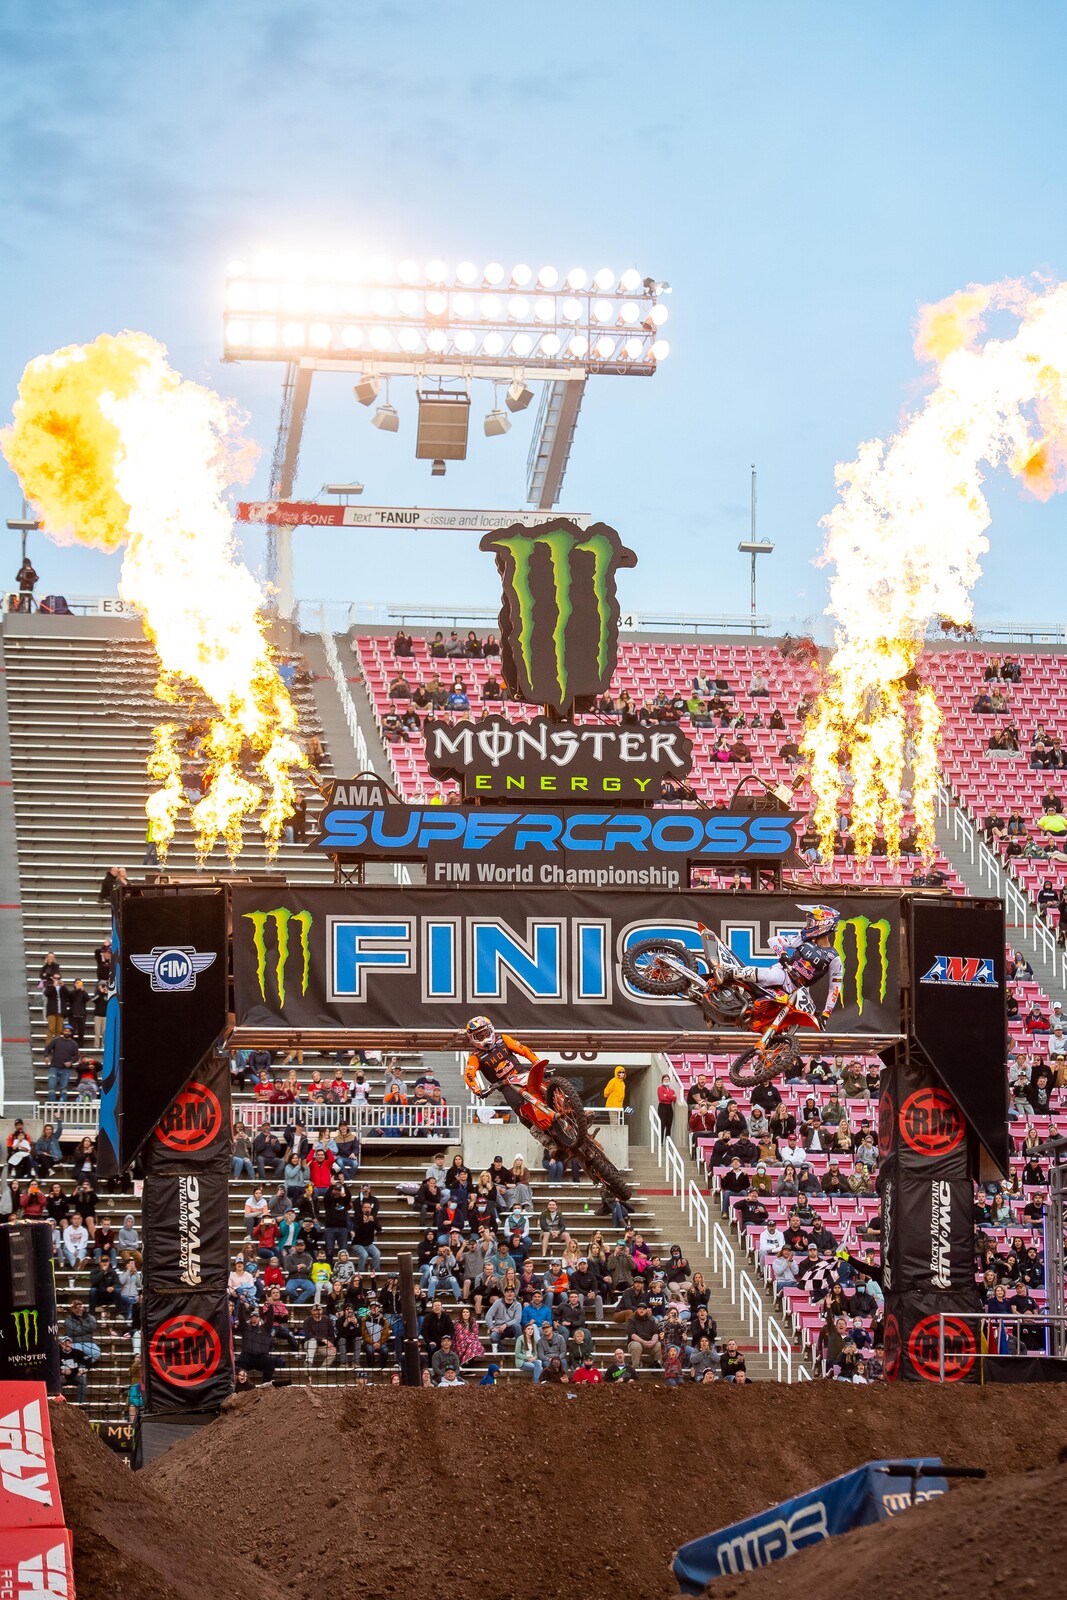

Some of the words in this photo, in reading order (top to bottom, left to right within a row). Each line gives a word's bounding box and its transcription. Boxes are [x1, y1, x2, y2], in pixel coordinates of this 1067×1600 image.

[353, 511, 372, 523] text
[459, 514, 477, 526] and
[332, 785, 385, 807] AMA
[475, 774, 653, 792] ENERGY
[317, 808, 797, 854] SUPERCROSS
[434, 862, 471, 882] FIM
[477, 862, 533, 884] World
[540, 863, 680, 888] Championship
[160, 960, 188, 978] FIM
[920, 955, 998, 984] AMA
[178, 1176, 189, 1231] MOUNTAIN
[930, 1180, 940, 1238] MOUNTAIN
[178, 1234, 189, 1268] ROCKY
[930, 1237, 940, 1273] ROCKY
[0, 1399, 53, 1506] FLY
